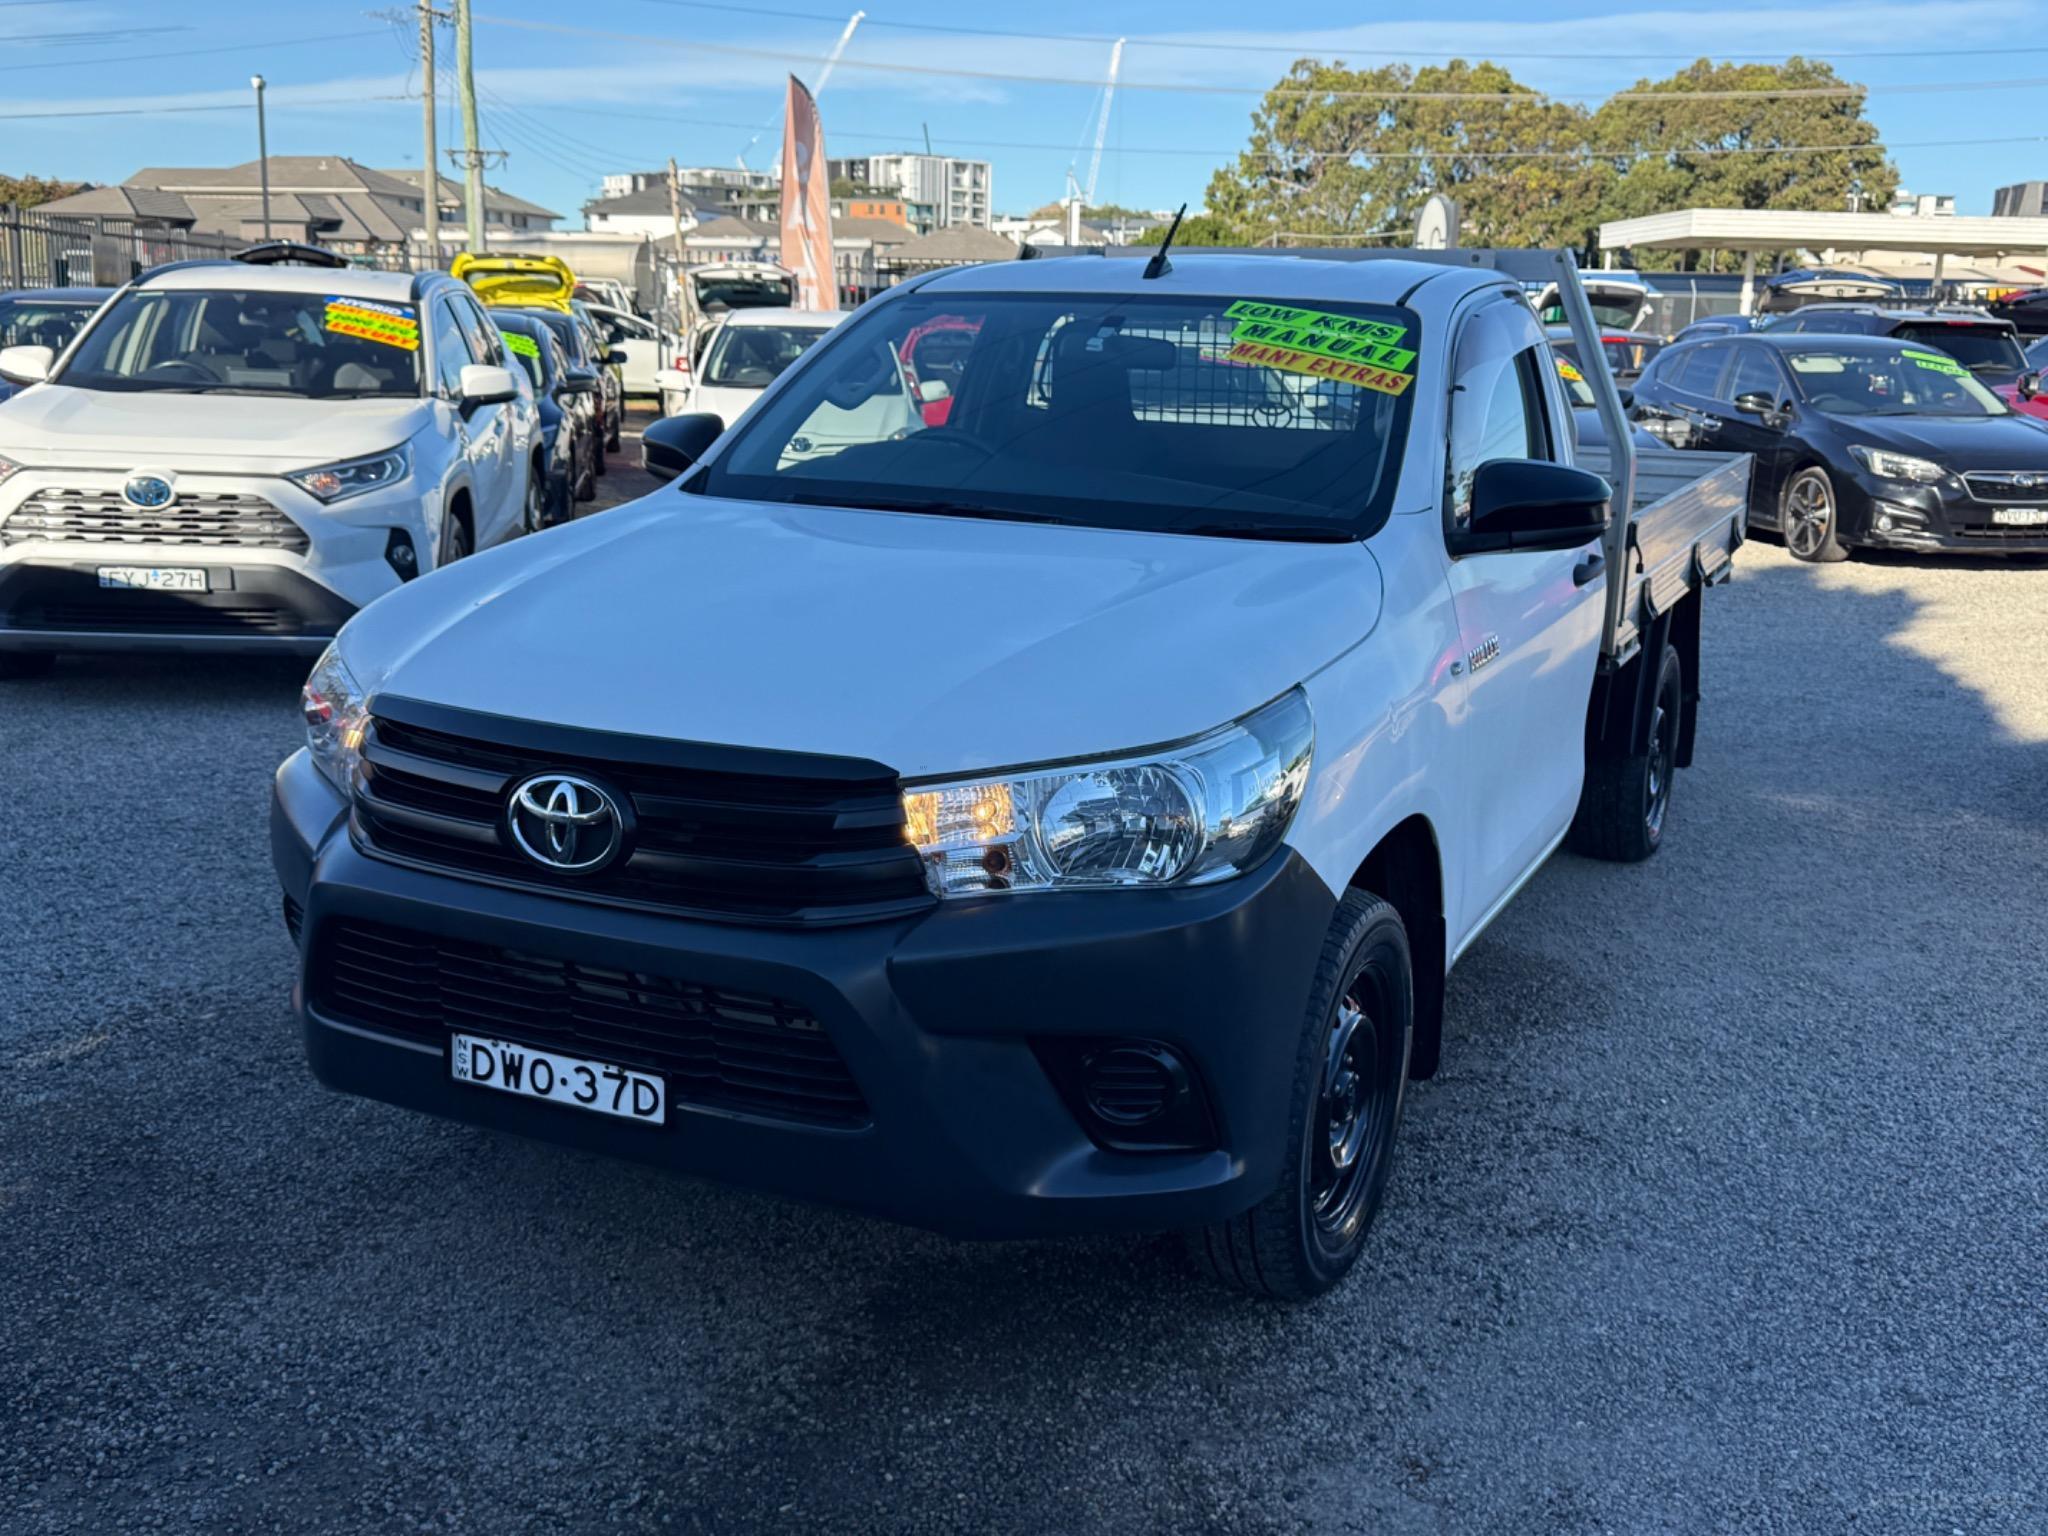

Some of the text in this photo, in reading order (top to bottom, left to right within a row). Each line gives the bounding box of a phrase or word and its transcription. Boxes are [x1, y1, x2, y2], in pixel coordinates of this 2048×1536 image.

[1232, 303, 1397, 339] LOW KMS
[1231, 342, 1304, 368] MANY
[1306, 357, 1405, 390] EXTRAS
[1241, 323, 1402, 367] MANUAL
